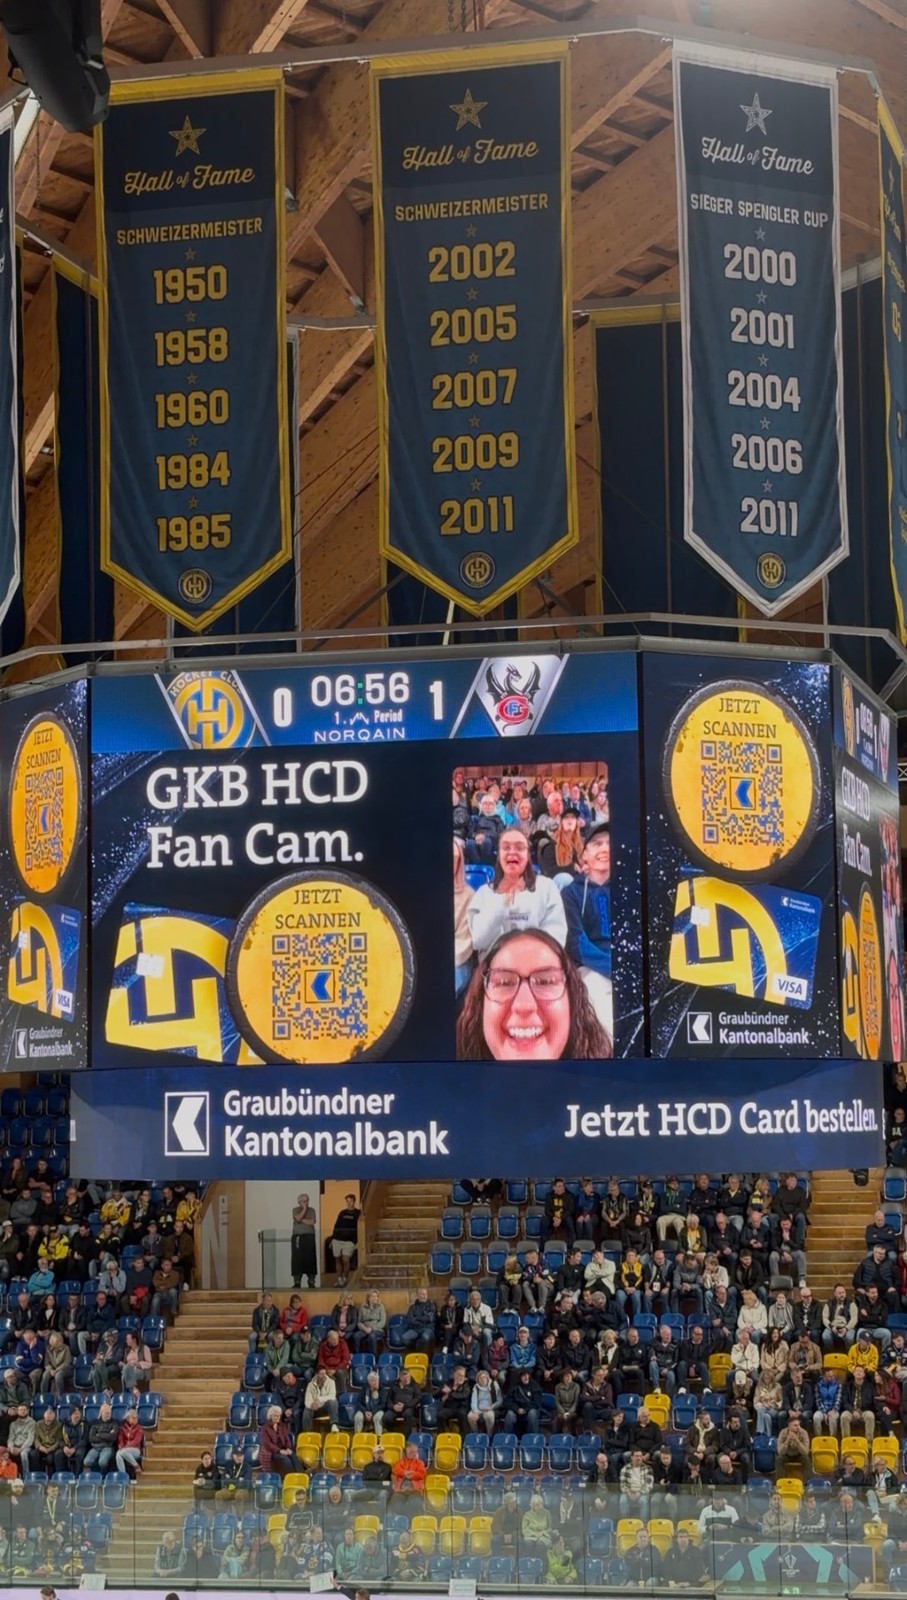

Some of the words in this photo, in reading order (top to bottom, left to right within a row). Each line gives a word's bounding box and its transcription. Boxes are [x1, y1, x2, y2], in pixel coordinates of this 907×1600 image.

[402, 144, 455, 171] Hall
[457, 147, 472, 162] of
[474, 139, 539, 164] Fame
[701, 136, 747, 163] Hall
[747, 150, 760, 165] of
[761, 146, 815, 175] Fame
[124, 169, 174, 195] Hall
[176, 173, 189, 188] of
[193, 165, 255, 189] Fame
[395, 193, 548, 222] SCHWEIZERMEISTER
[690, 193, 733, 215] SIEGER
[738, 200, 800, 225] SPENGLER
[803, 210, 829, 228] CUP
[116, 217, 262, 245] SCHWEIZERMEISTER
[428, 240, 516, 283] 2002
[724, 243, 797, 286] 2000
[153, 265, 228, 304] 1950
[430, 304, 517, 347] 2005
[730, 307, 795, 349] 2001
[155, 327, 229, 366] 1958
[432, 368, 518, 409] 2007
[727, 370, 801, 412] 2004
[155, 388, 230, 428] 1960
[155, 451, 231, 491] 1984
[432, 431, 520, 473] 2009
[731, 433, 804, 475] 2006
[156, 513, 232, 552] 1985
[440, 496, 514, 535] 2011
[740, 497, 799, 537] 2011
[220, 671, 242, 694] CLU
[310, 672, 410, 707] 06:56
[429, 680, 443, 720] 1
[273, 687, 293, 728] 0
[334, 711, 347, 724] 1.
[374, 709, 403, 723] Period
[719, 697, 760, 714] JETZT
[314, 727, 406, 742] NORQAIN
[703, 720, 777, 738] SCANNEN
[26, 748, 62, 770] SCANNEN
[146, 765, 250, 810] GKB
[261, 760, 369, 806] HCD
[146, 826, 233, 868] Fan
[245, 822, 364, 865] Cam.
[293, 888, 342, 905] JETZT
[274, 912, 362, 929] SCANNEN
[57, 993, 71, 1008] VISA
[777, 978, 803, 995] VISA
[719, 1011, 789, 1025] Graubündner
[719, 1027, 810, 1045] Kantonalbank
[29, 1040, 73, 1057] Kantonalbank
[223, 1087, 395, 1116] Graubündner
[565, 1104, 650, 1138] Jetzt
[658, 1102, 732, 1136] HCD
[739, 1099, 800, 1134] Card
[805, 1100, 878, 1133] bestellen.
[224, 1120, 450, 1157] Kantonalbank
